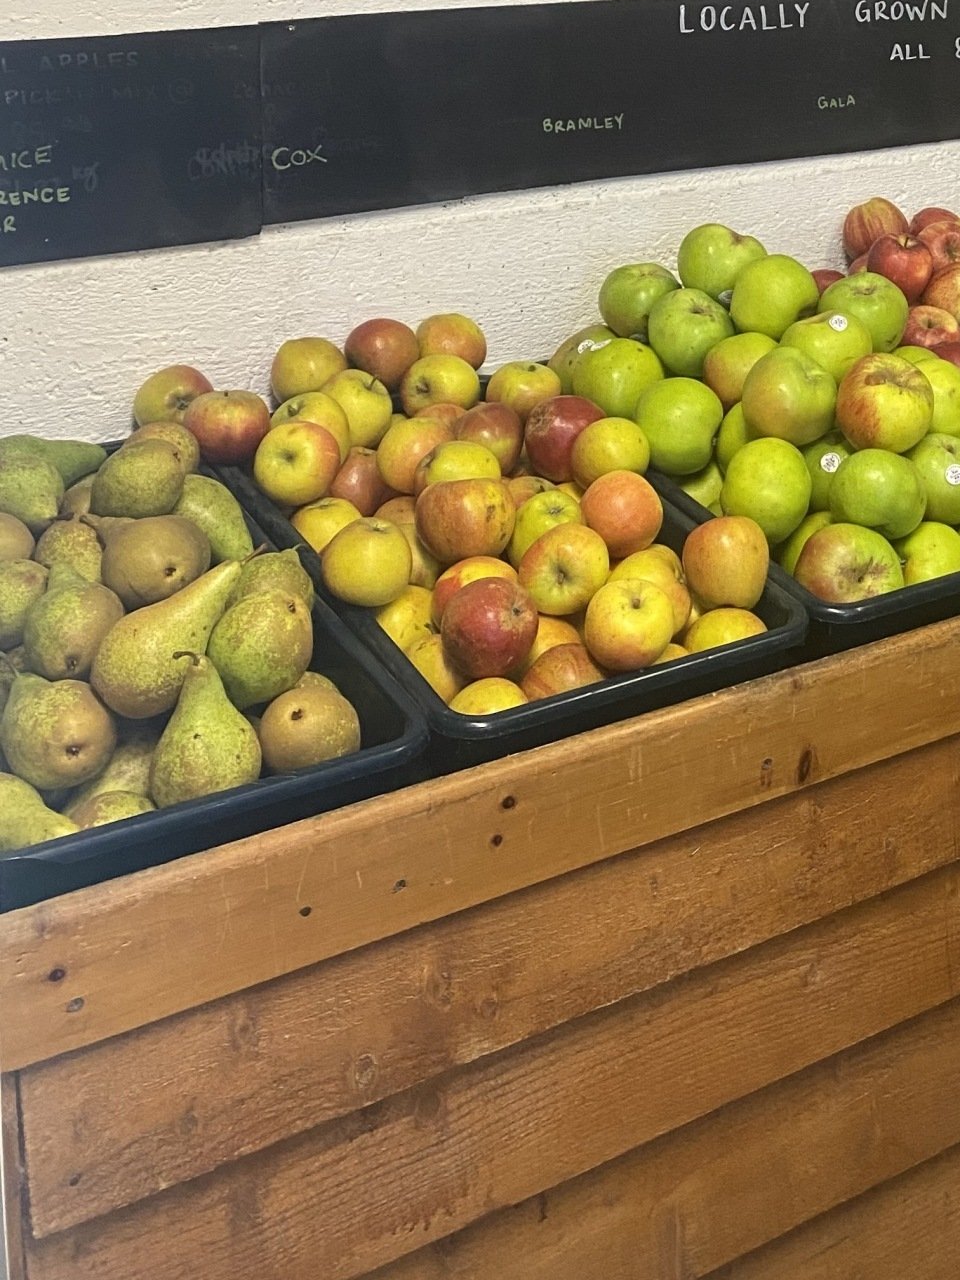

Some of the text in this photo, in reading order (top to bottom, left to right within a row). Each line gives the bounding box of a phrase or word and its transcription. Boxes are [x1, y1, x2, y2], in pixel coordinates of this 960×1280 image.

[678, 1, 810, 34] LOCALLY
[890, 42, 931, 61] ALL
[817, 94, 856, 111] GALA
[542, 113, 625, 134] BRAMLEY
